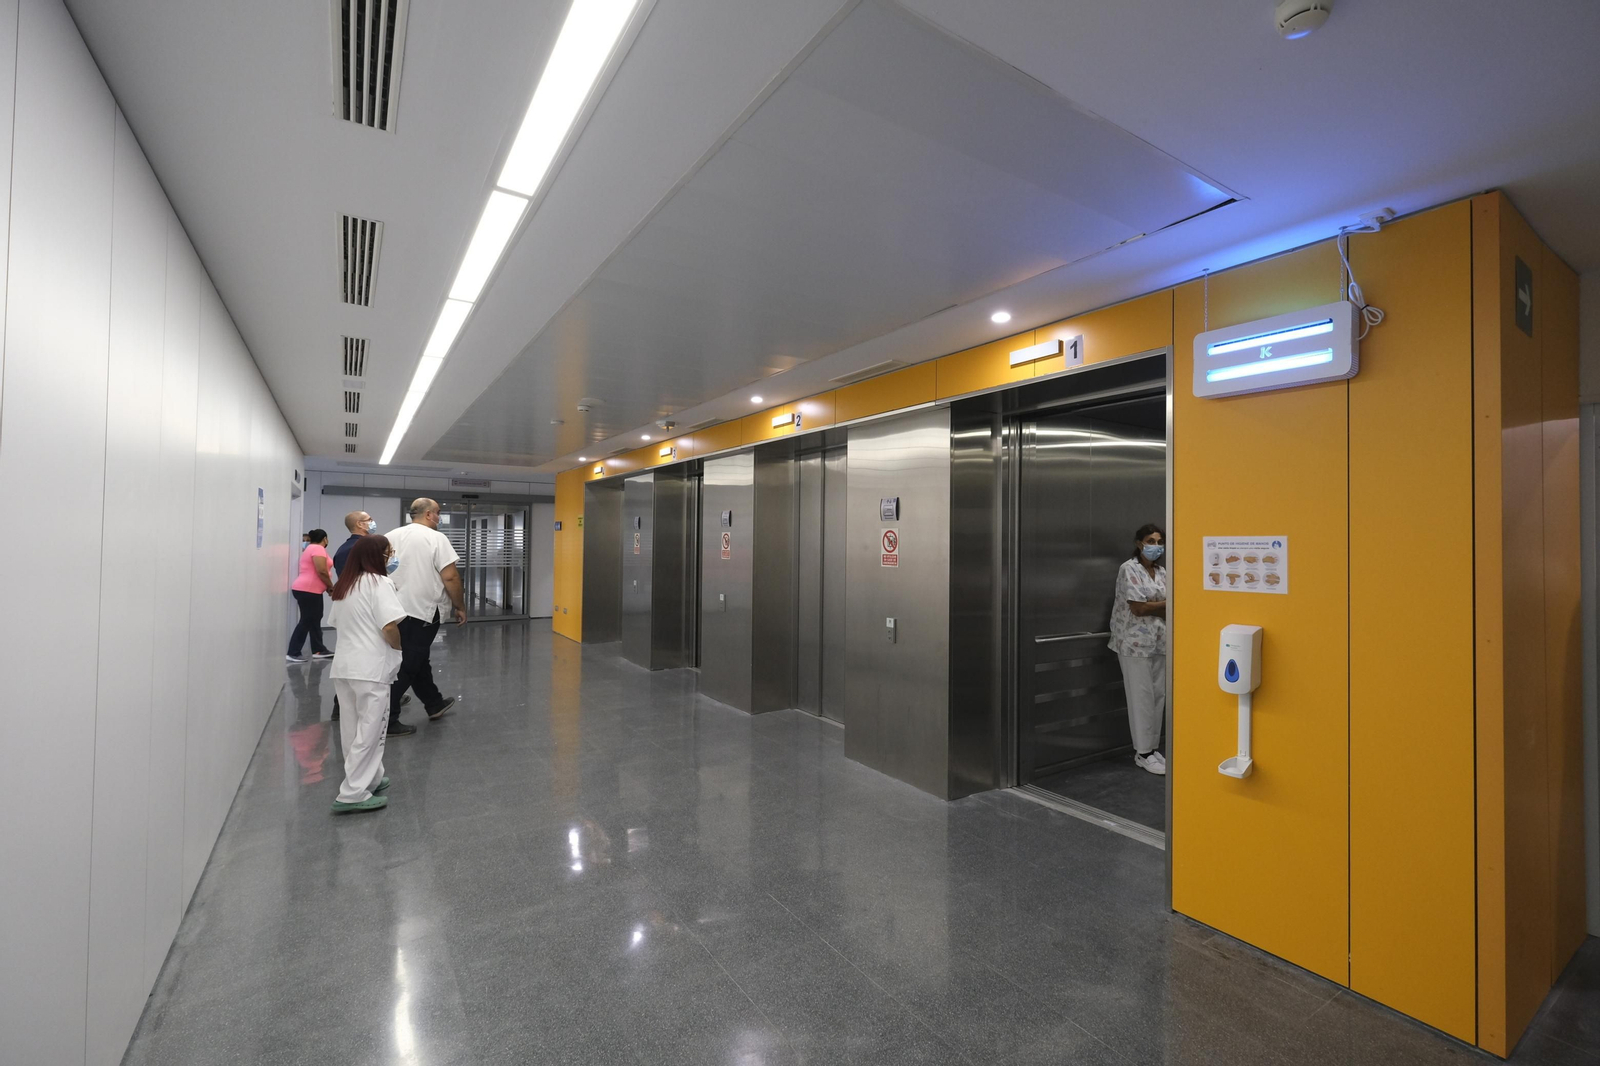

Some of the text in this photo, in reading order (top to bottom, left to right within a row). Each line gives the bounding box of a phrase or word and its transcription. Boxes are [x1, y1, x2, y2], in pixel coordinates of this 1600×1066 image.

[1070, 340, 1078, 359] 1
[1260, 346, 1272, 359] K
[796, 414, 802, 426] 2
